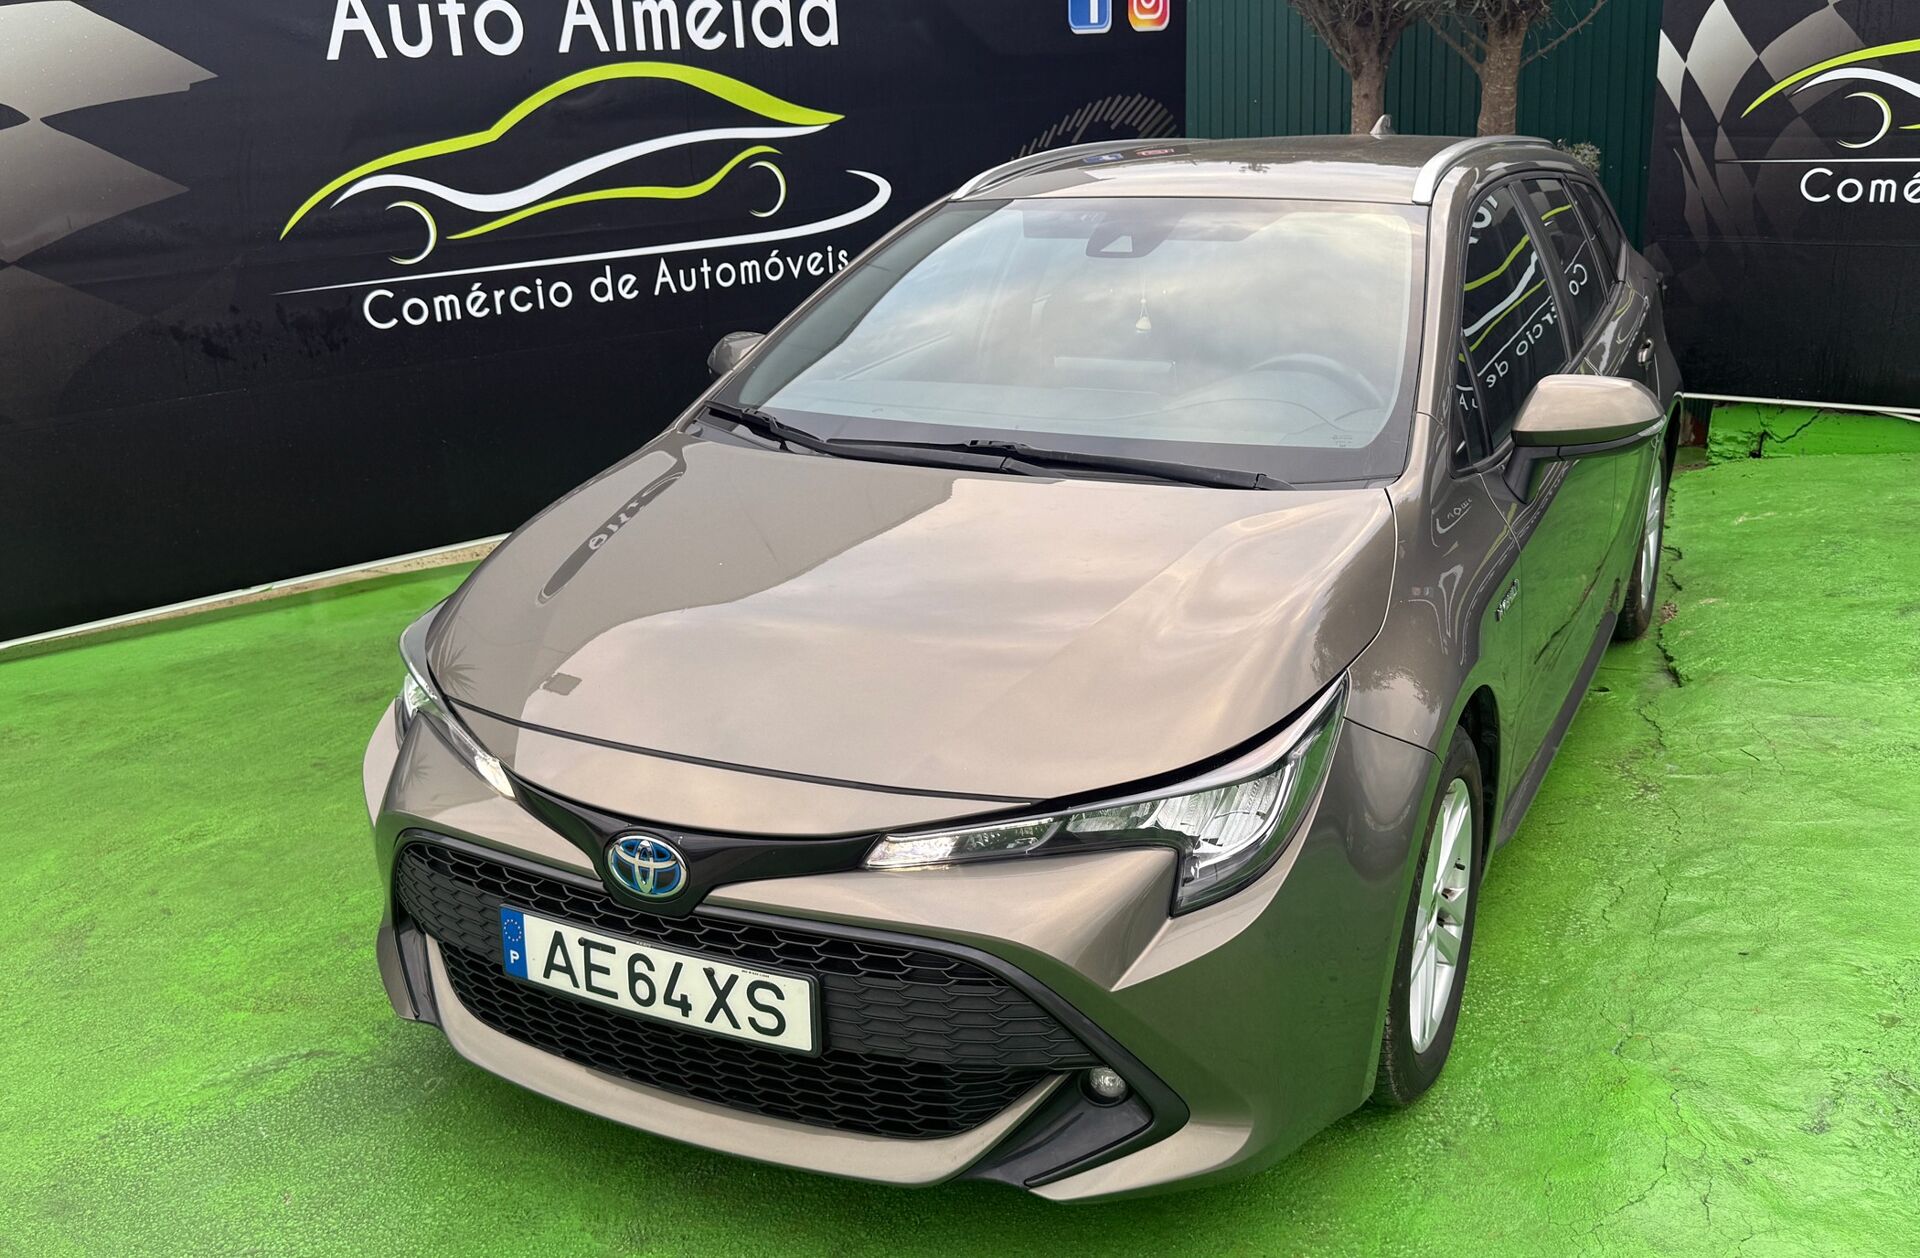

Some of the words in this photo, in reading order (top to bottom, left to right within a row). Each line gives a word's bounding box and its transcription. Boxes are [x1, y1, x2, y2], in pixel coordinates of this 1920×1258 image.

[326, 0, 524, 61] Auto
[558, 0, 839, 54] Almeida
[363, 278, 573, 330] Comércio
[589, 264, 639, 303] de
[654, 245, 850, 296] Automóveis
[509, 949, 520, 964] P
